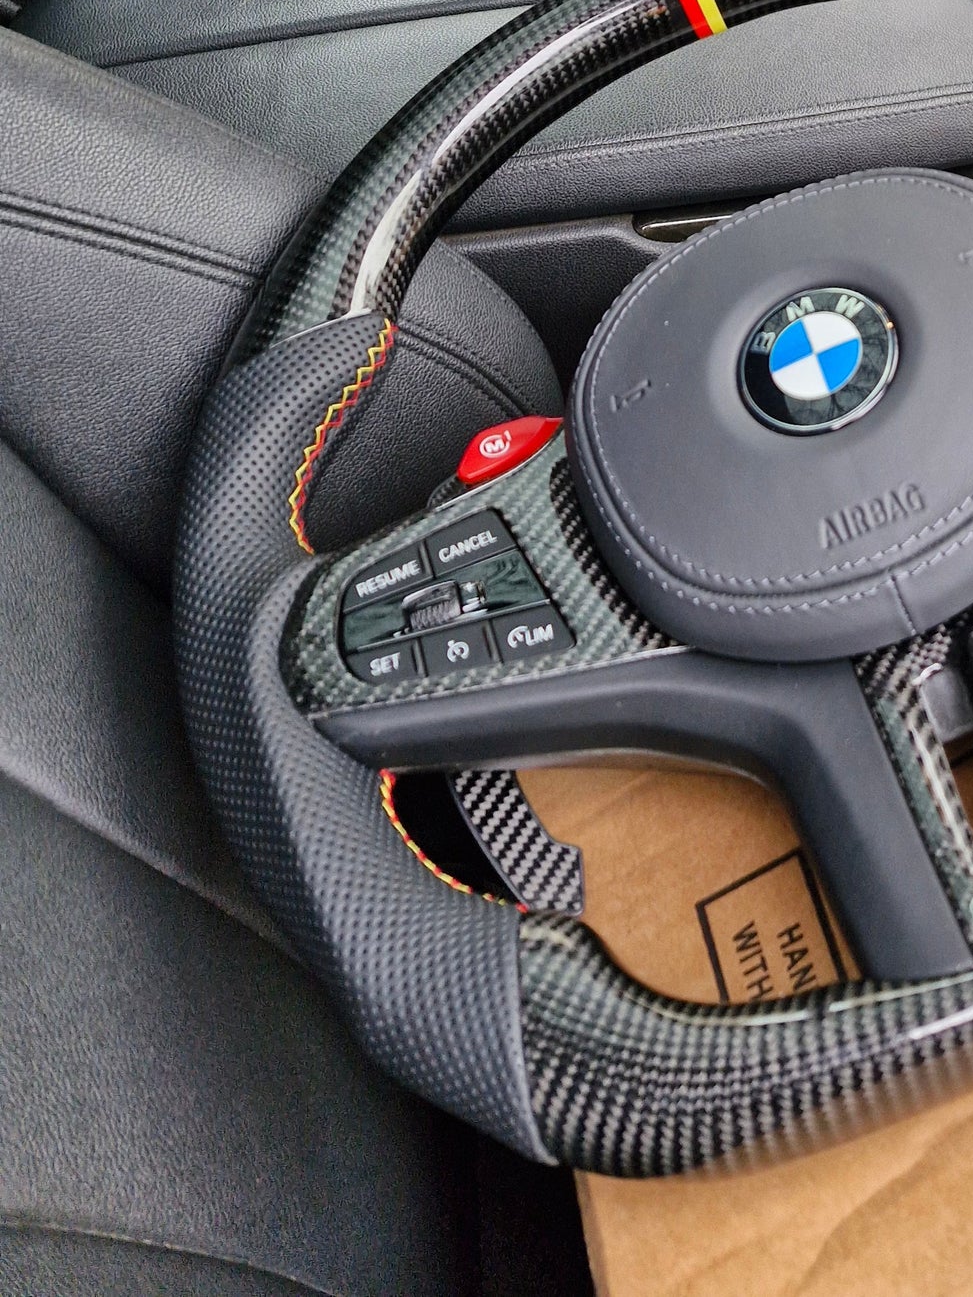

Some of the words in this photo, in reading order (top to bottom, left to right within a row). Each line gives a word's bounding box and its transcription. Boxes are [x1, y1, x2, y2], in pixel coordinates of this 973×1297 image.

[753, 296, 865, 354] BMW
[819, 482, 926, 550] AIRBAG
[438, 530, 498, 564] CANCEL
[355, 560, 421, 598] RESUME
[525, 623, 554, 643] LIM
[369, 652, 401, 677] SET
[733, 920, 774, 1000] WITH
